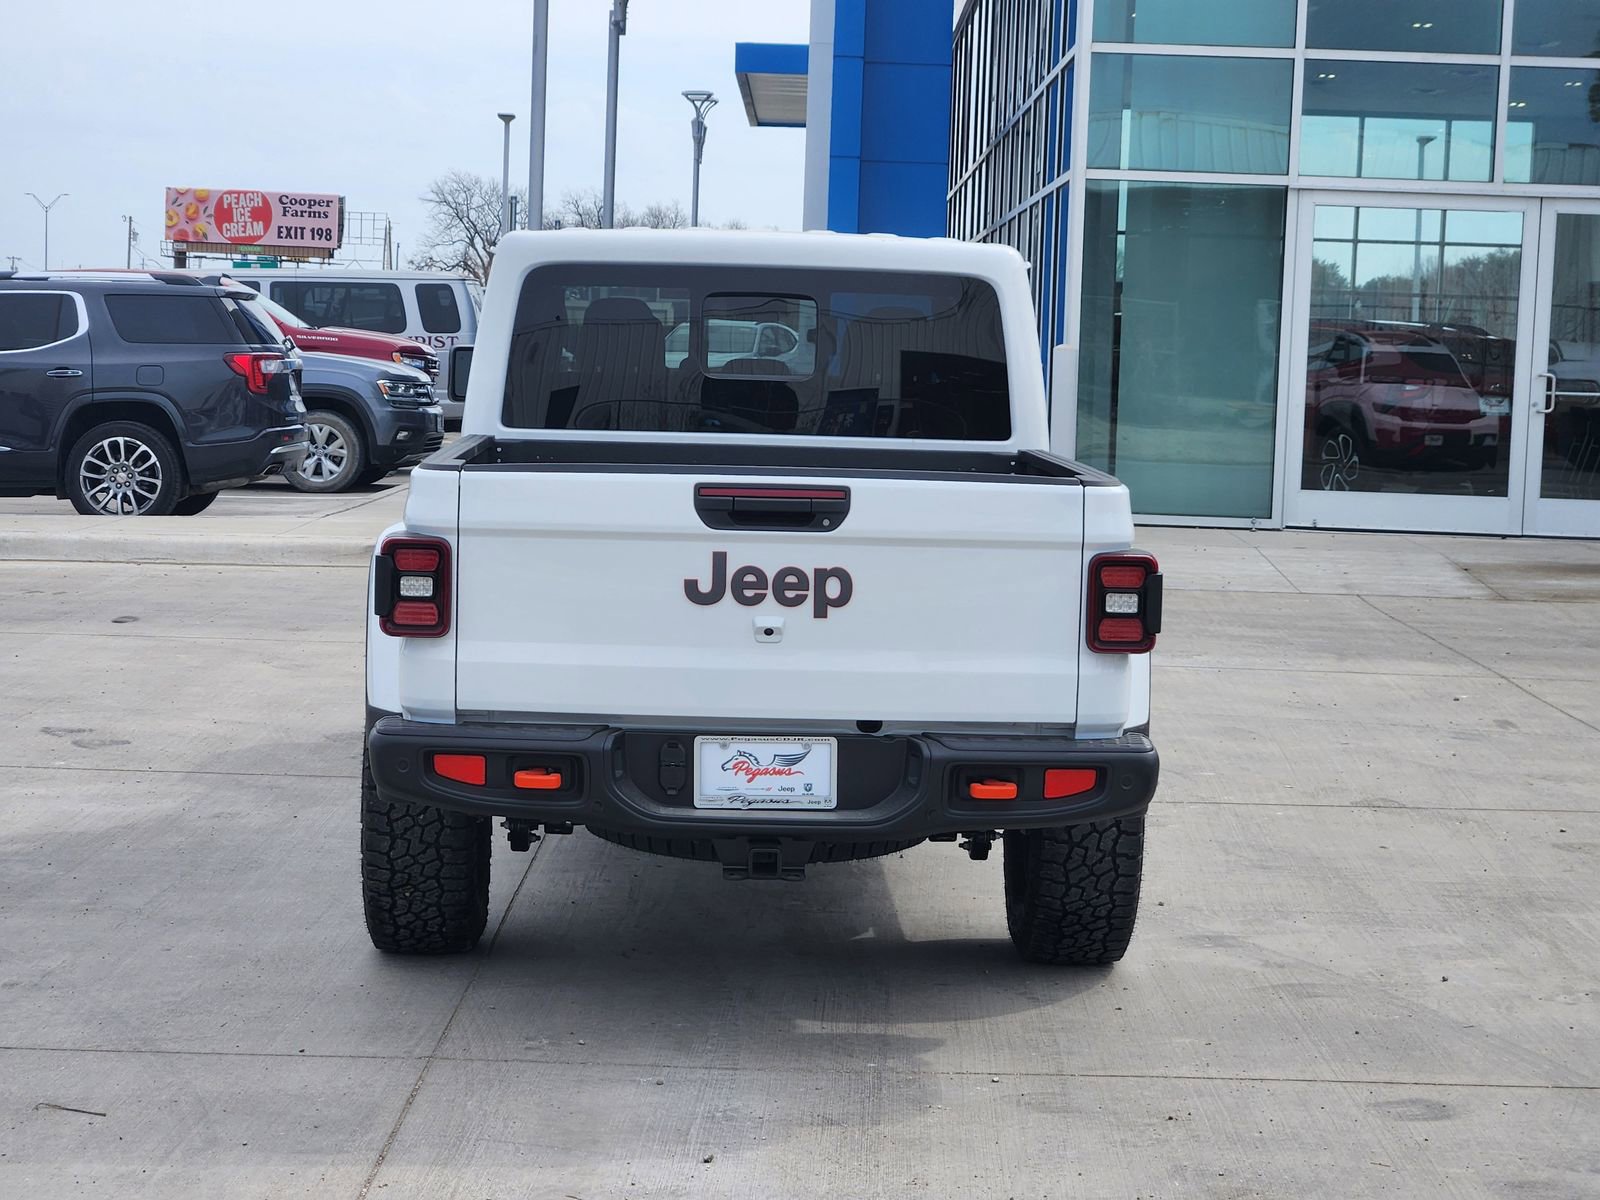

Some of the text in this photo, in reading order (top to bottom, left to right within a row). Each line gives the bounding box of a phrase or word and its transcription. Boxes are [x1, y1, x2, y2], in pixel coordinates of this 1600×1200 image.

[223, 191, 263, 208] PEACH
[278, 195, 333, 209] Cooper
[232, 207, 252, 222] ICE
[282, 206, 329, 219] Farms
[222, 221, 264, 238] CREAM
[277, 225, 333, 242] EXIT 198
[296, 334, 339, 342] SILVERADO
[684, 551, 853, 619] Jeep
[732, 760, 805, 784] Pegasus
[778, 785, 795, 793] Jeep
[727, 795, 803, 808] Pegasus
